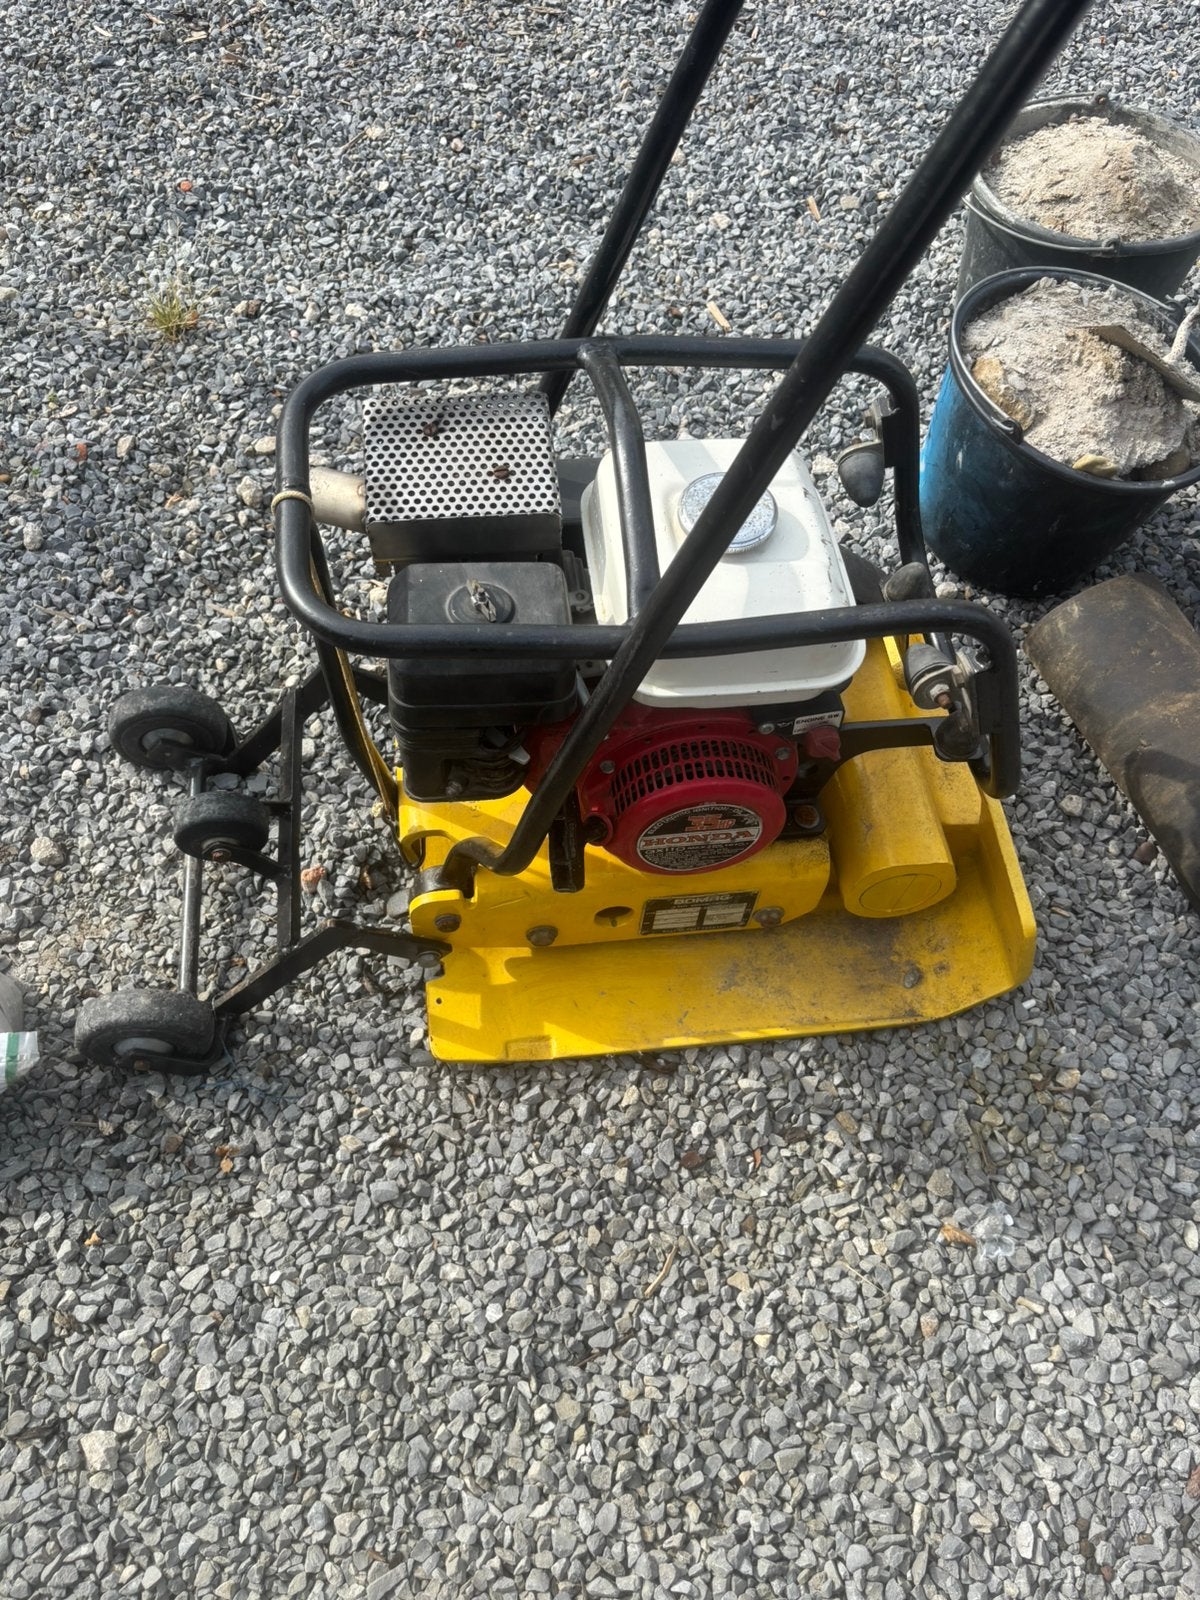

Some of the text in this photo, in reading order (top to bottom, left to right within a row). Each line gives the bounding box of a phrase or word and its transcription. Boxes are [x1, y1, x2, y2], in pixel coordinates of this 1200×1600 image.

[796, 716, 826, 724] ENGINE
[642, 830, 755, 847] HONDA
[673, 894, 731, 905] BOMAG
